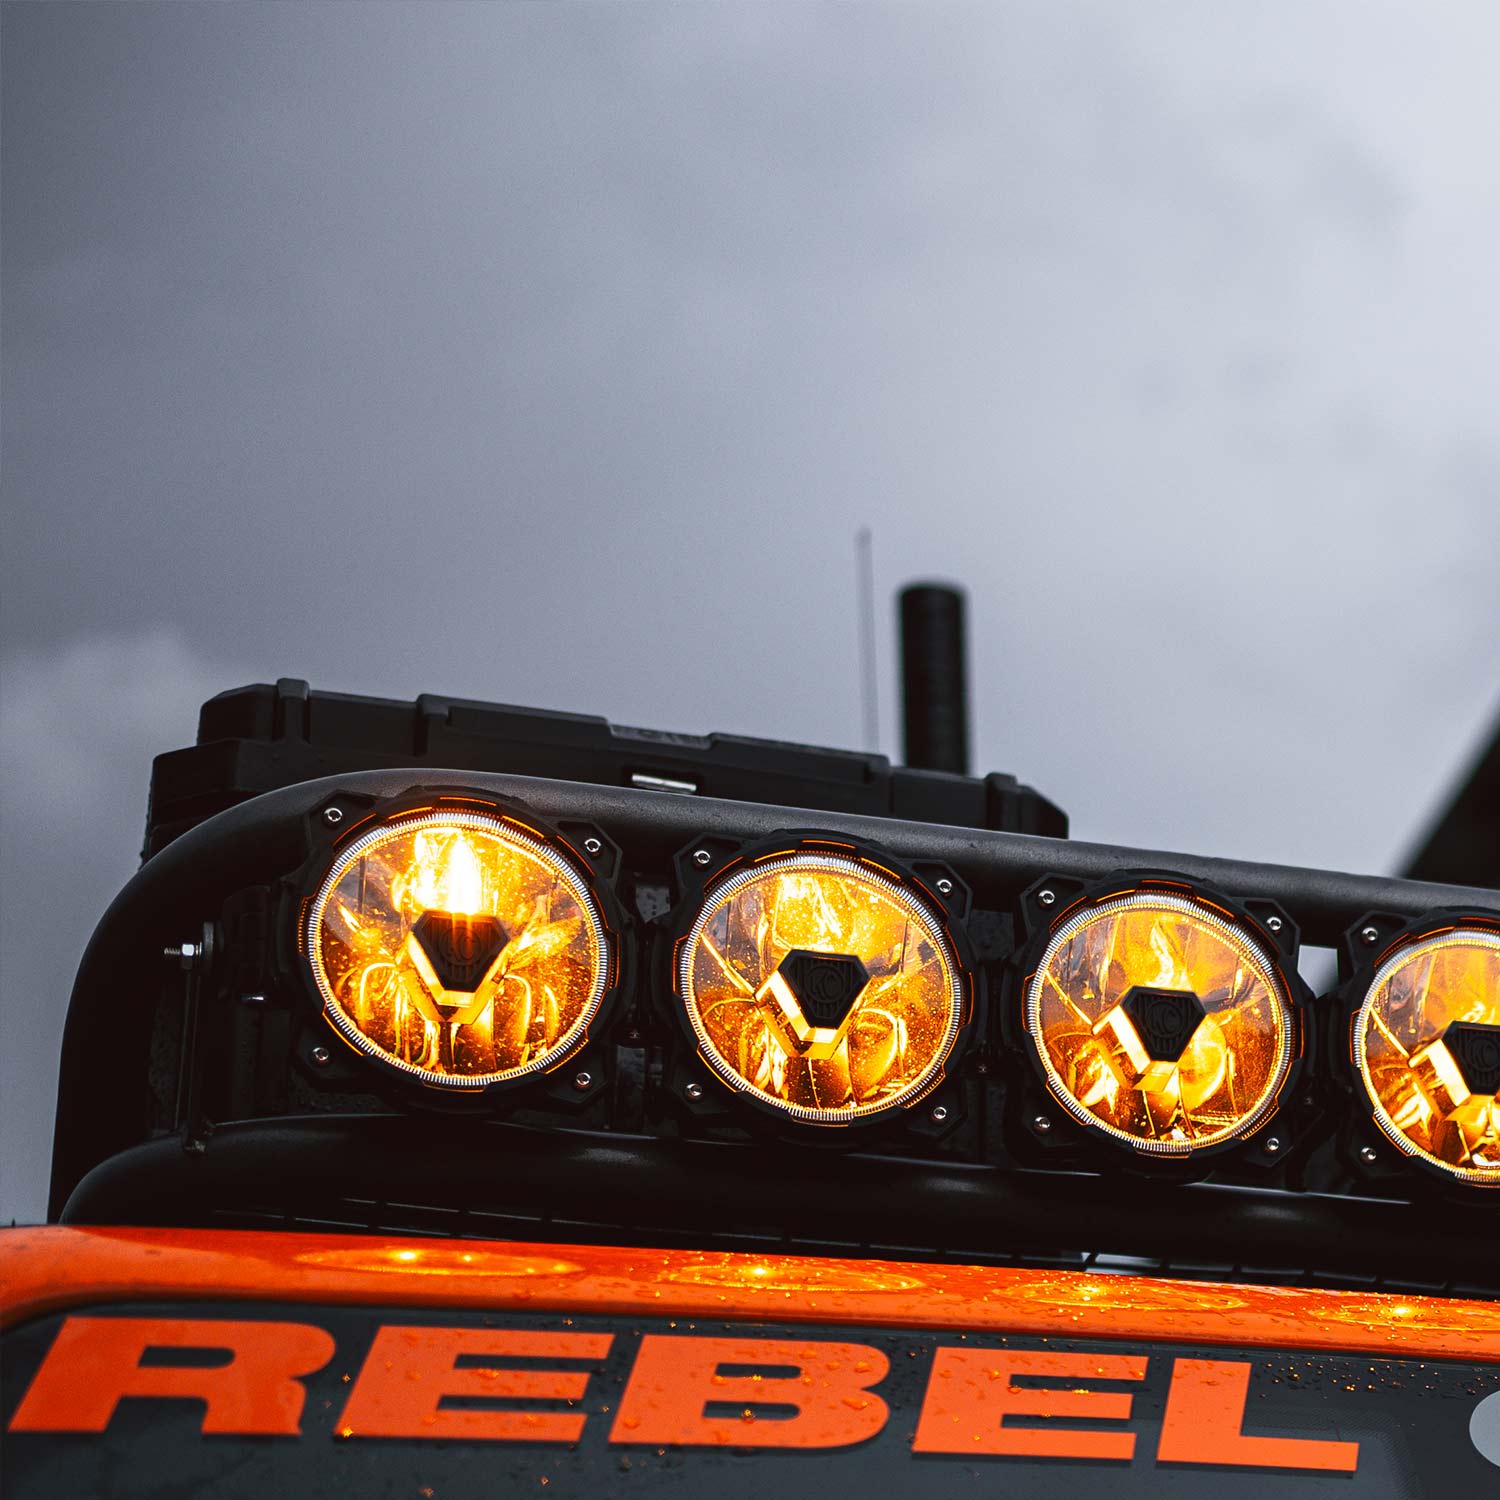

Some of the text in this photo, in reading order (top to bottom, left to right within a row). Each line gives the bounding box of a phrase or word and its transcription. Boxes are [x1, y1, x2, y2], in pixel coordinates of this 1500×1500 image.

[811, 969, 843, 999] KC
[1150, 1005, 1181, 1034] KC
[1470, 1041, 1499, 1069] KC
[8, 1316, 1359, 1473] REBEL
